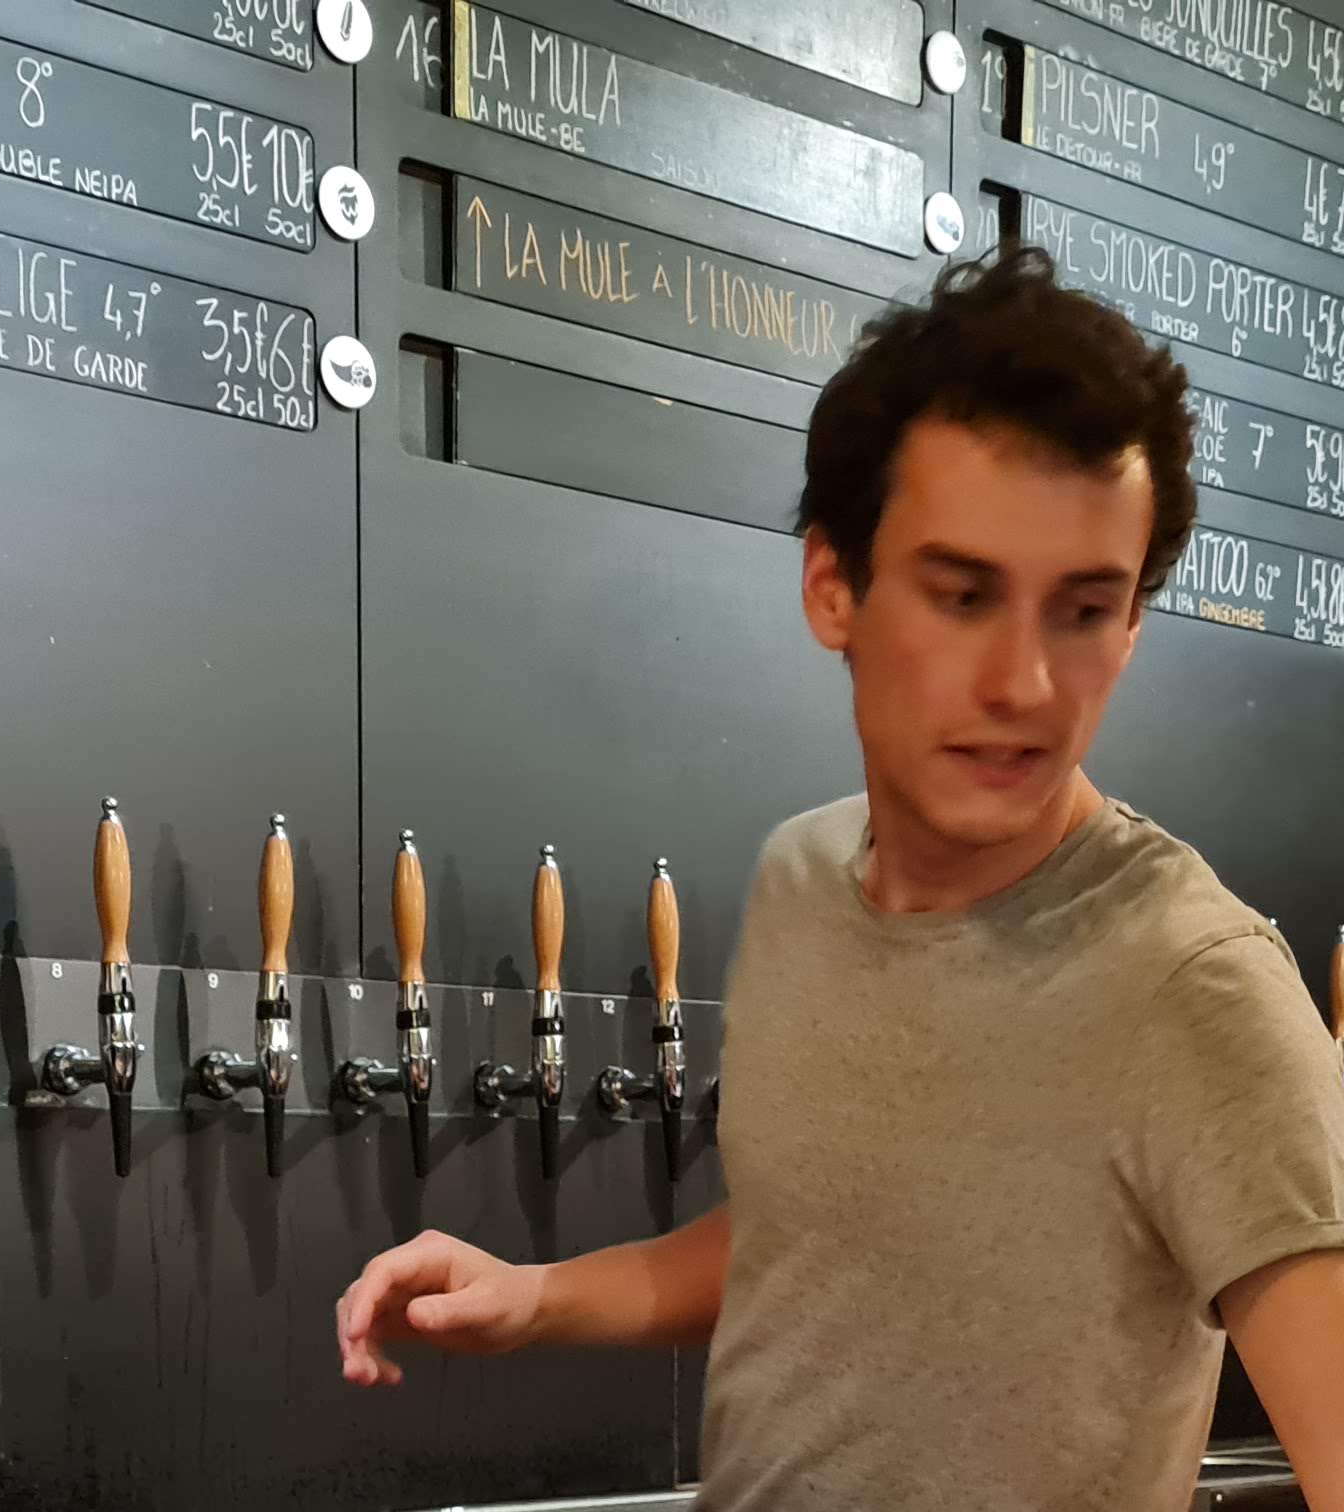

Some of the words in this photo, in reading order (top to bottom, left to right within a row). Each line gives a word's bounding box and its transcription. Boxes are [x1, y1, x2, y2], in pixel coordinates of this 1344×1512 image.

[212, 11, 255, 49] 25cl
[269, 29, 313, 72] 50cl
[470, 5, 510, 92] LA
[529, 27, 623, 126] MULA
[1184, 37, 1202, 64] DE
[1204, 43, 1245, 83] GARDE
[16, 56, 54, 128] 8°
[1040, 52, 1160, 158] PILSNER
[469, 86, 489, 123] LA
[650, 150, 719, 192] SAISON
[1035, 125, 1052, 151] LE
[74, 167, 138, 208] NEIPA
[196, 191, 240, 227] 25cl
[264, 207, 312, 246] 50cl
[503, 212, 548, 287] LA
[558, 227, 641, 304] MULE
[1088, 220, 1197, 308] SMOKED
[1206, 257, 1295, 340] PORTER
[1151, 308, 1200, 343] PORTER
[26, 334, 56, 372] DE
[73, 344, 149, 393] GARDE
[216, 380, 264, 420] 25cl
[272, 393, 314, 429] 50cl
[1248, 420, 1275, 471] 7°
[1201, 464, 1226, 489] IPA
[51, 961, 64, 980] 8
[207, 973, 220, 990] 9
[348, 984, 365, 1001] 10
[481, 990, 496, 1008] 11
[600, 997, 617, 1015] 12
